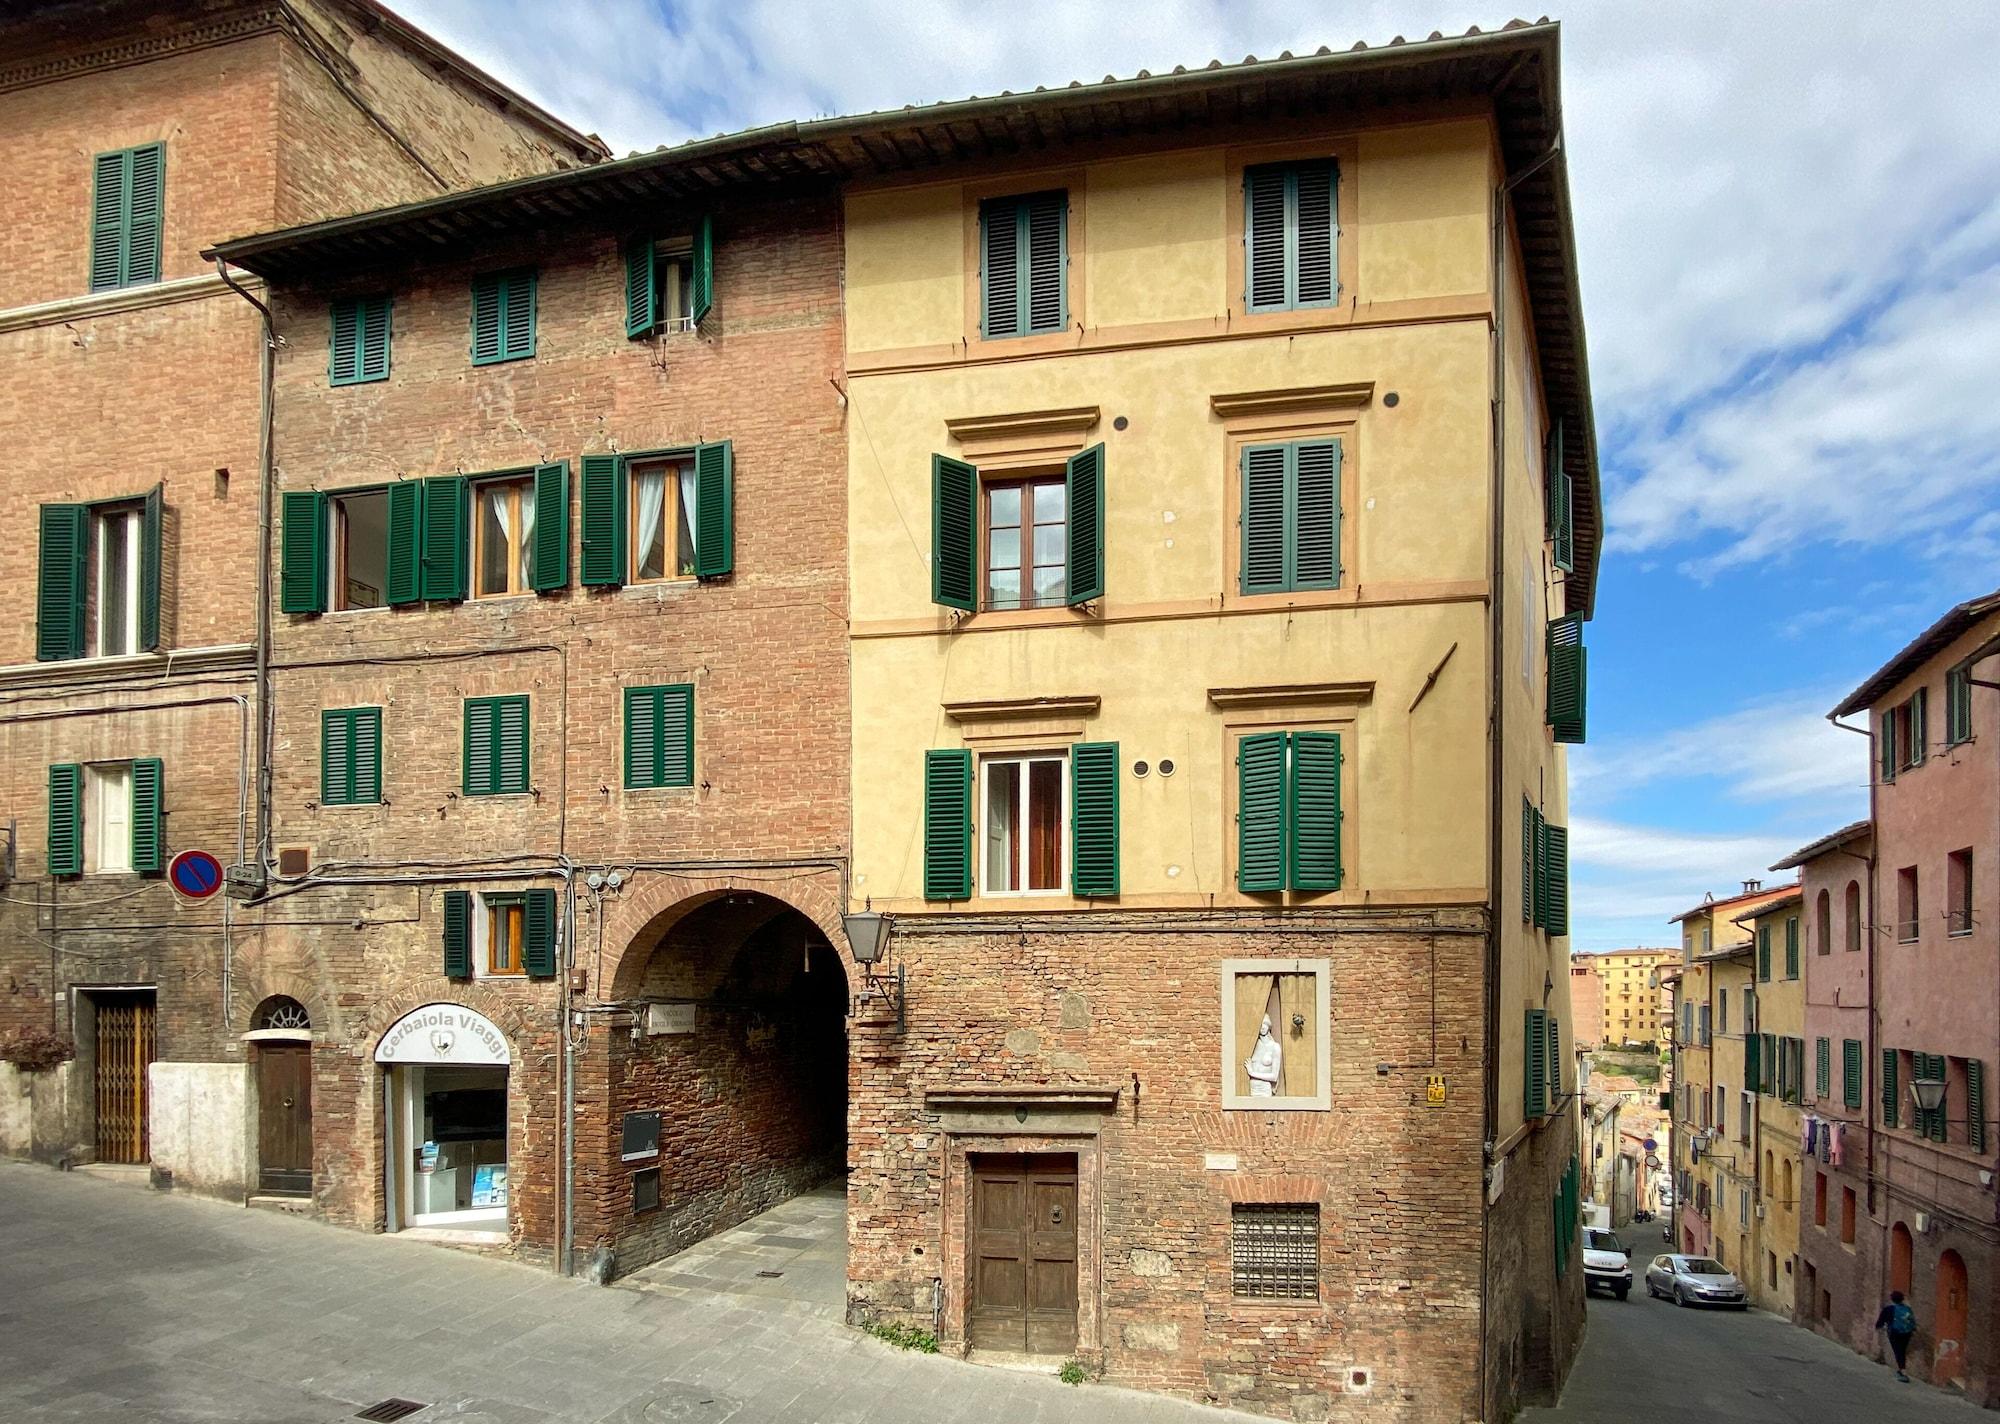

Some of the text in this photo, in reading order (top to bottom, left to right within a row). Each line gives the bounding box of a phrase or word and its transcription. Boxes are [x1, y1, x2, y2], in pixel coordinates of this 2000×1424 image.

[235, 870, 252, 878] 0-24
[383, 1012, 507, 1060] Cerbaiola Viaggi
